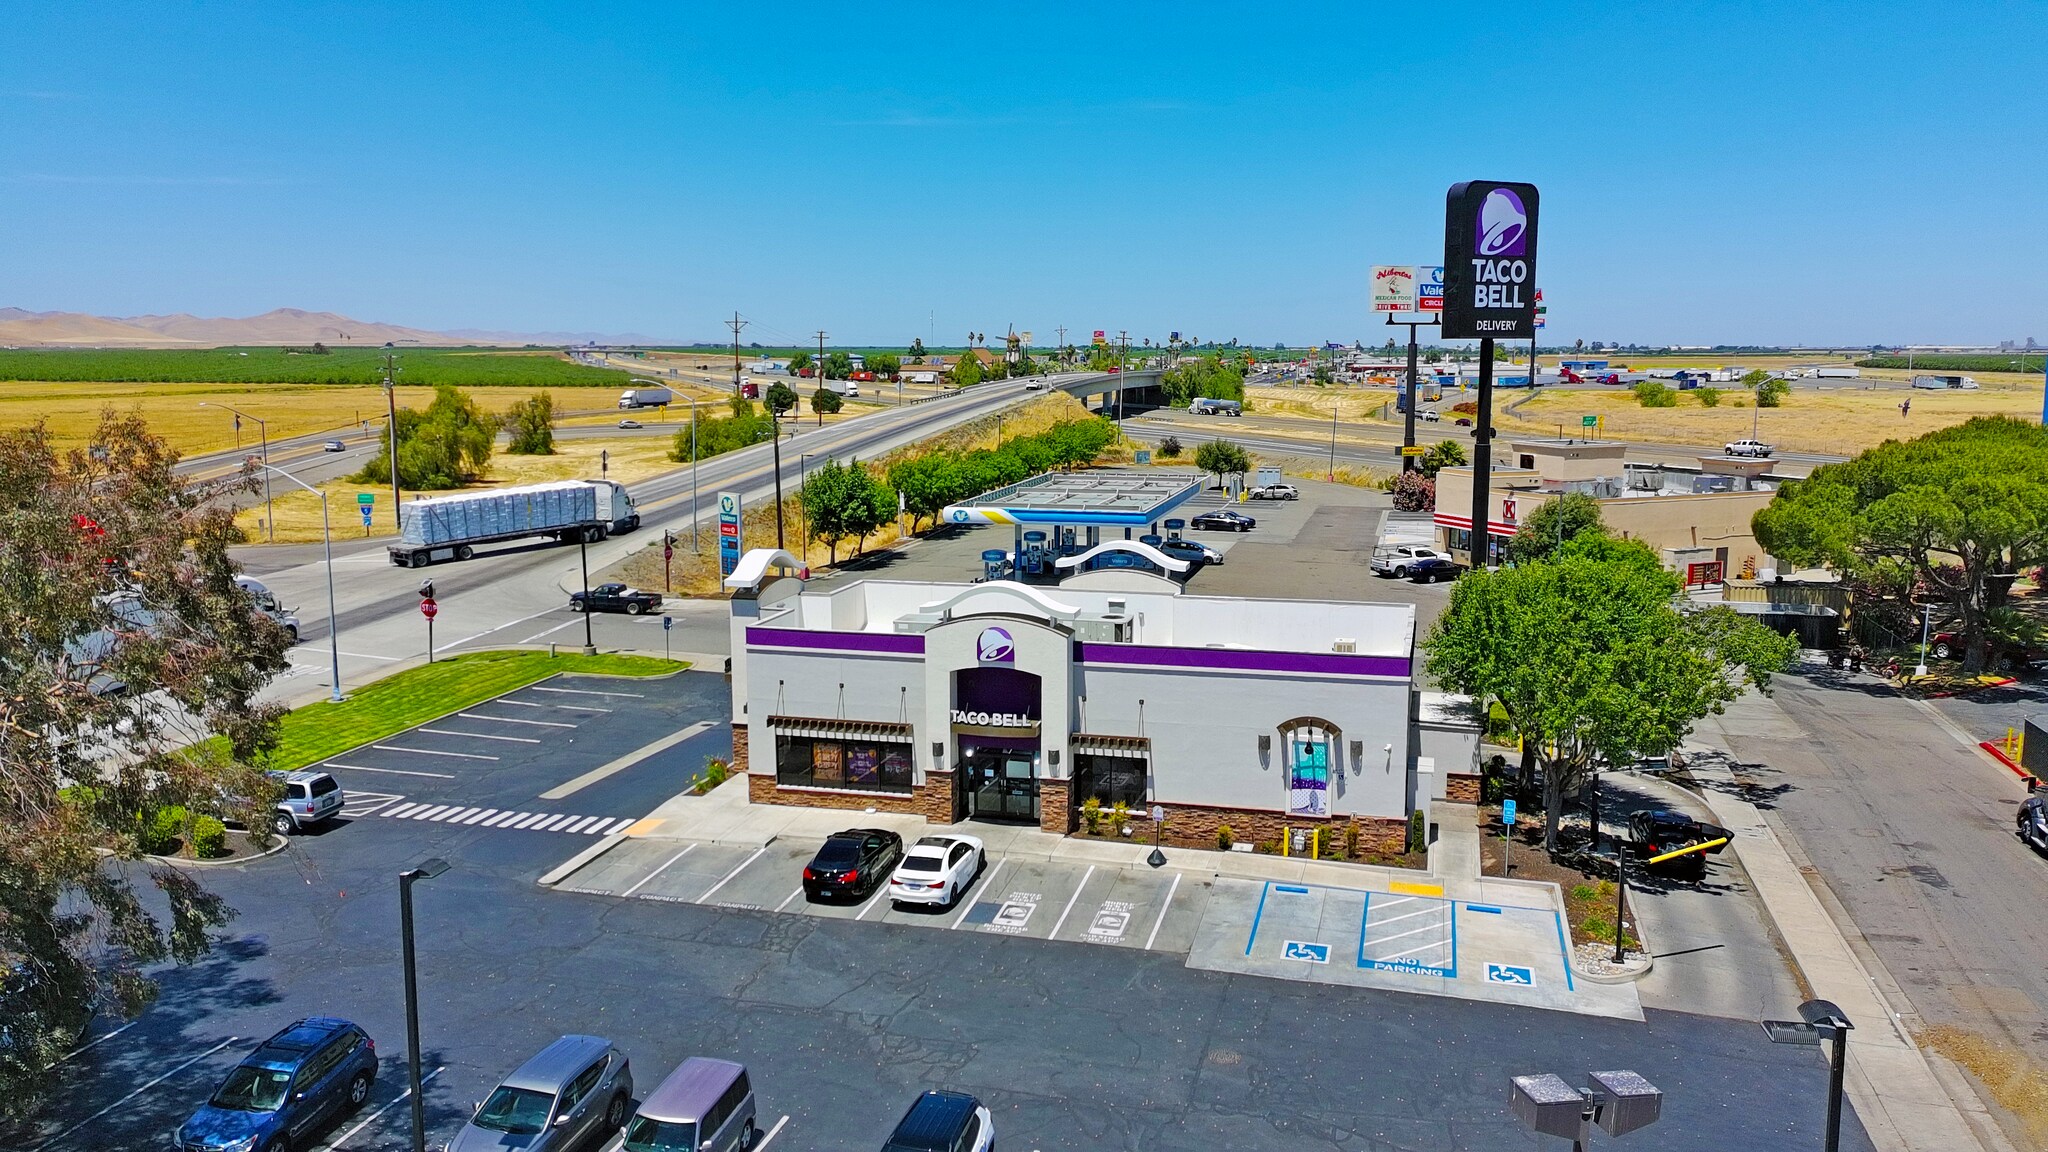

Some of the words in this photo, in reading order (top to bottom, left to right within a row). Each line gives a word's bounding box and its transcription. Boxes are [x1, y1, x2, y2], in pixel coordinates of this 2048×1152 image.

[1472, 259, 1527, 283] TACO
[1474, 285, 1524, 308] BELL
[1476, 320, 1518, 331] DELIVERY
[421, 603, 438, 612] STOP
[950, 709, 990, 726] TACO
[992, 713, 1031, 727] BELL
[568, 887, 612, 896] COMPACT
[640, 894, 684, 902] COMPACT
[718, 902, 762, 910] COMPACT
[1395, 957, 1418, 965] NO
[1374, 963, 1443, 977] PARKING
